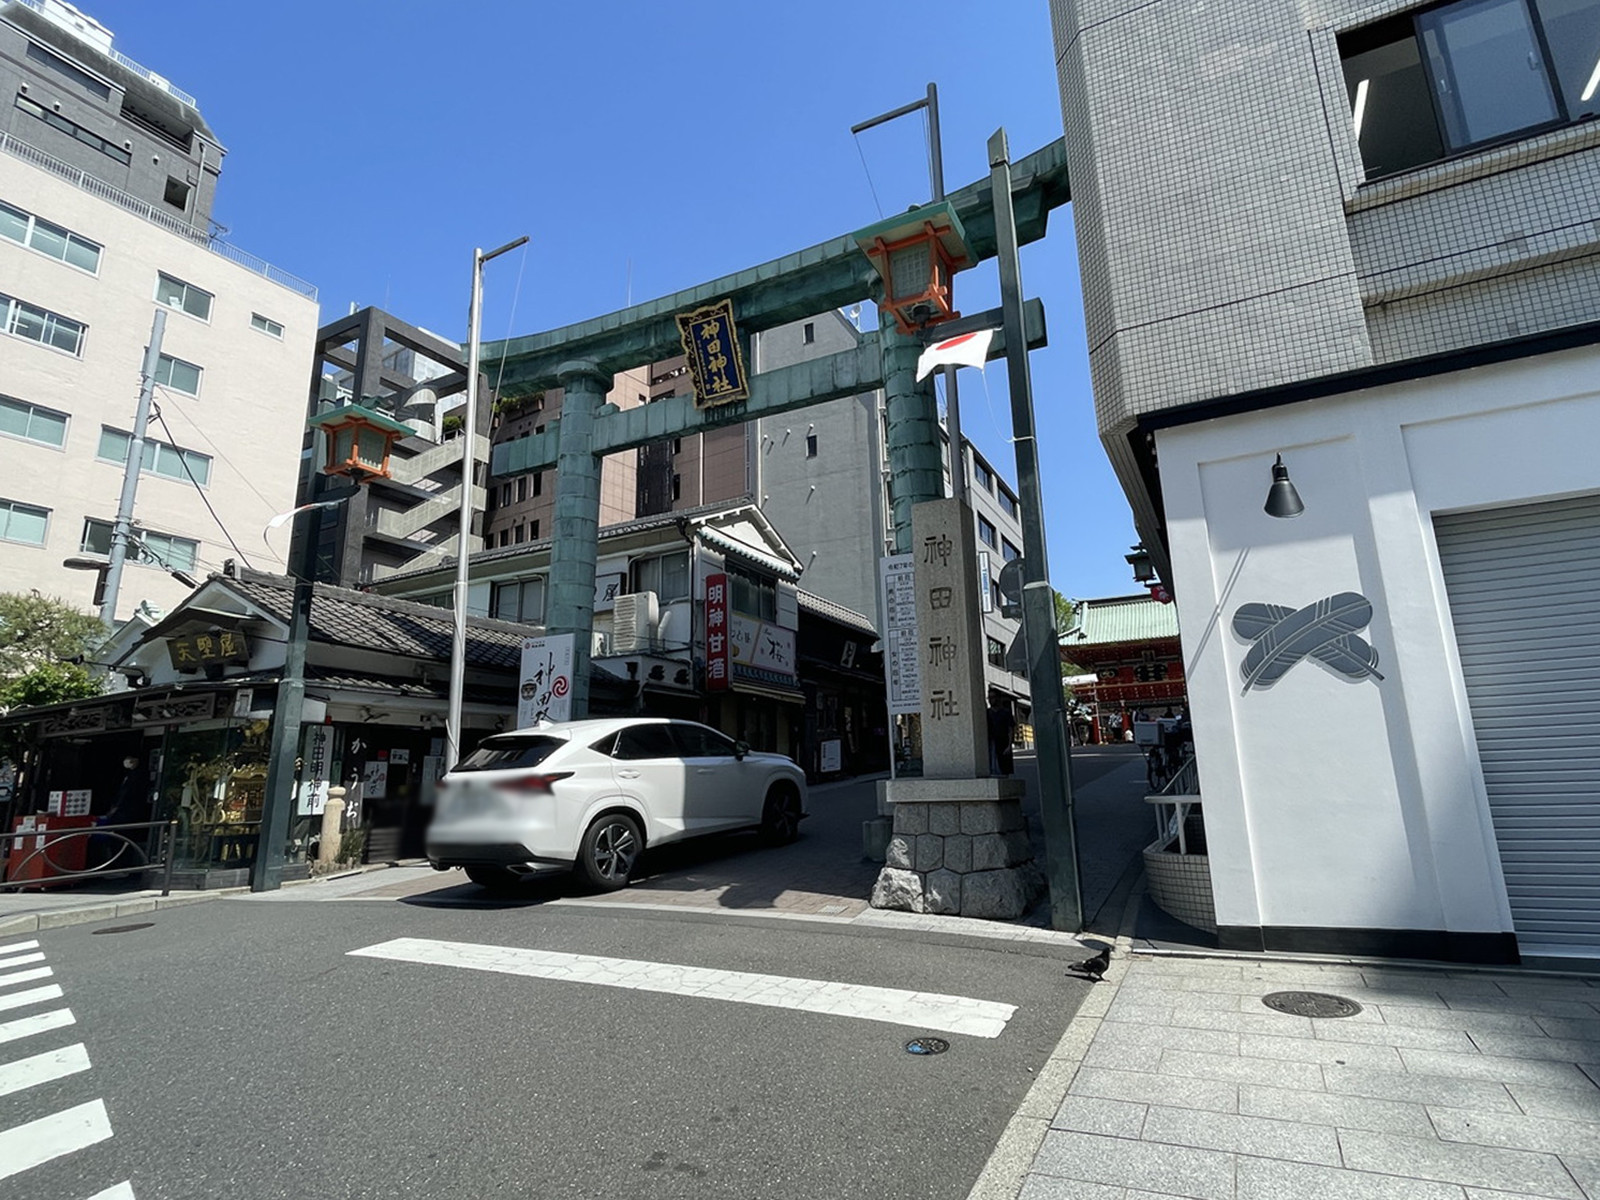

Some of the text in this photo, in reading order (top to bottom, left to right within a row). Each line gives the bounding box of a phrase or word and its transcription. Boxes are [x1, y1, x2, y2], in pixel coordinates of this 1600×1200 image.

[701, 320, 733, 392] 神田神社
[708, 584, 725, 679] 明神甘酒
[924, 534, 960, 720] 神田神社
[306, 731, 327, 808] 神田明神前
